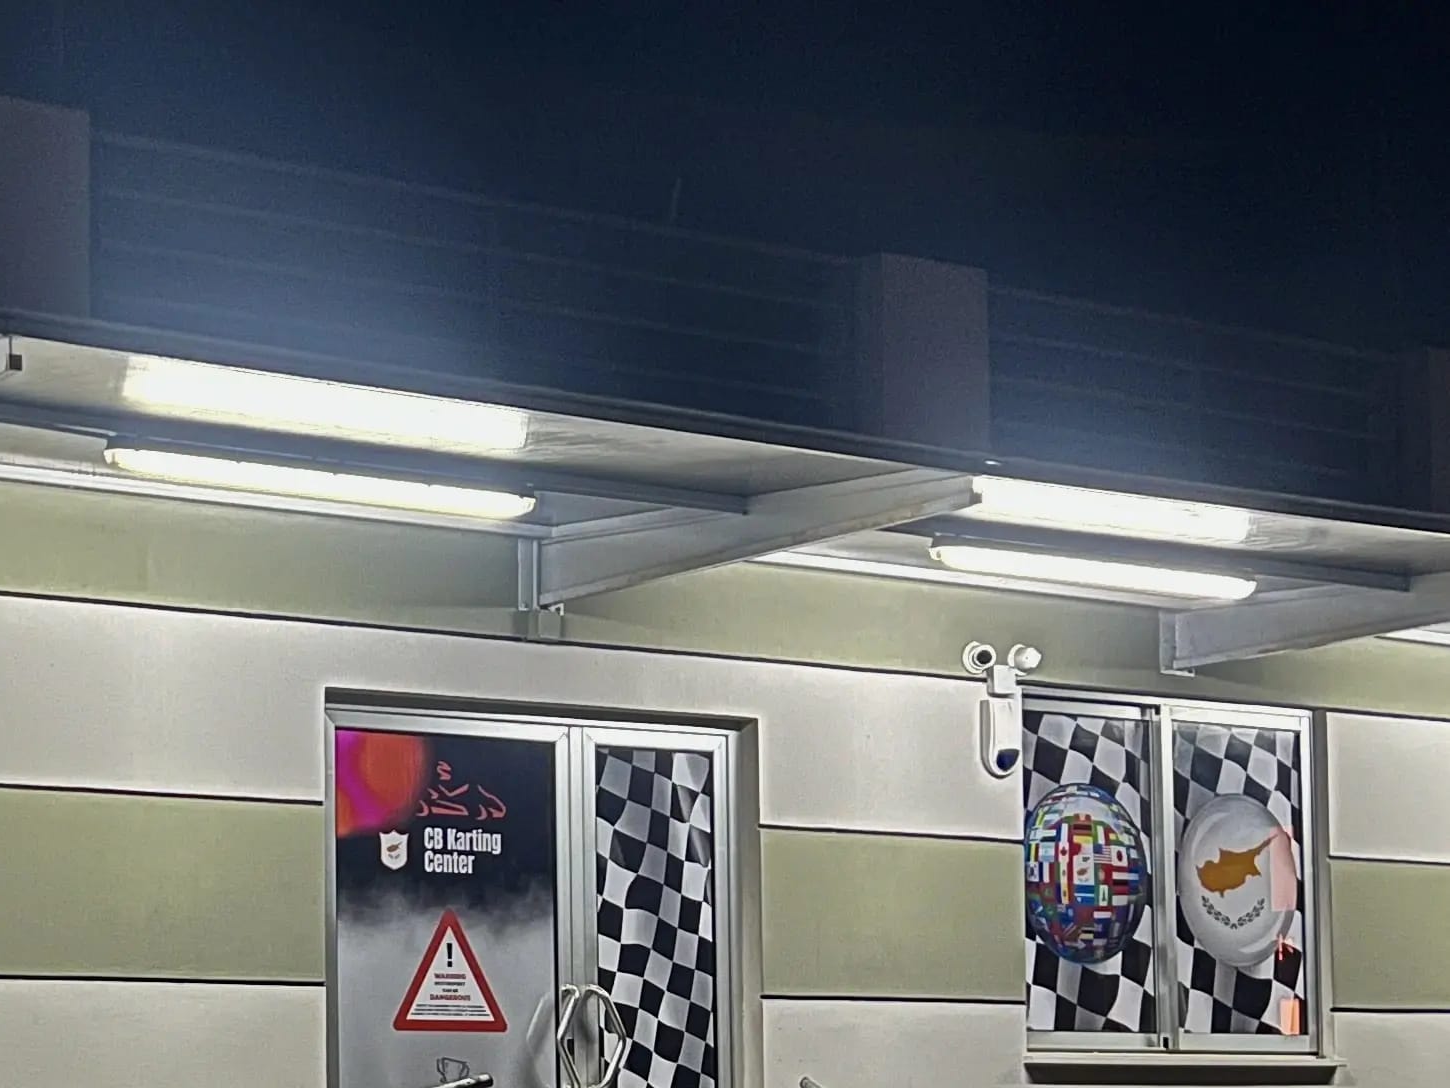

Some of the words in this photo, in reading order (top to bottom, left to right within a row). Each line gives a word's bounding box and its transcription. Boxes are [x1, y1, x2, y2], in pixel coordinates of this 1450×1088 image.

[423, 826, 444, 850] CB
[446, 828, 502, 855] Karting
[423, 850, 476, 874] Center
